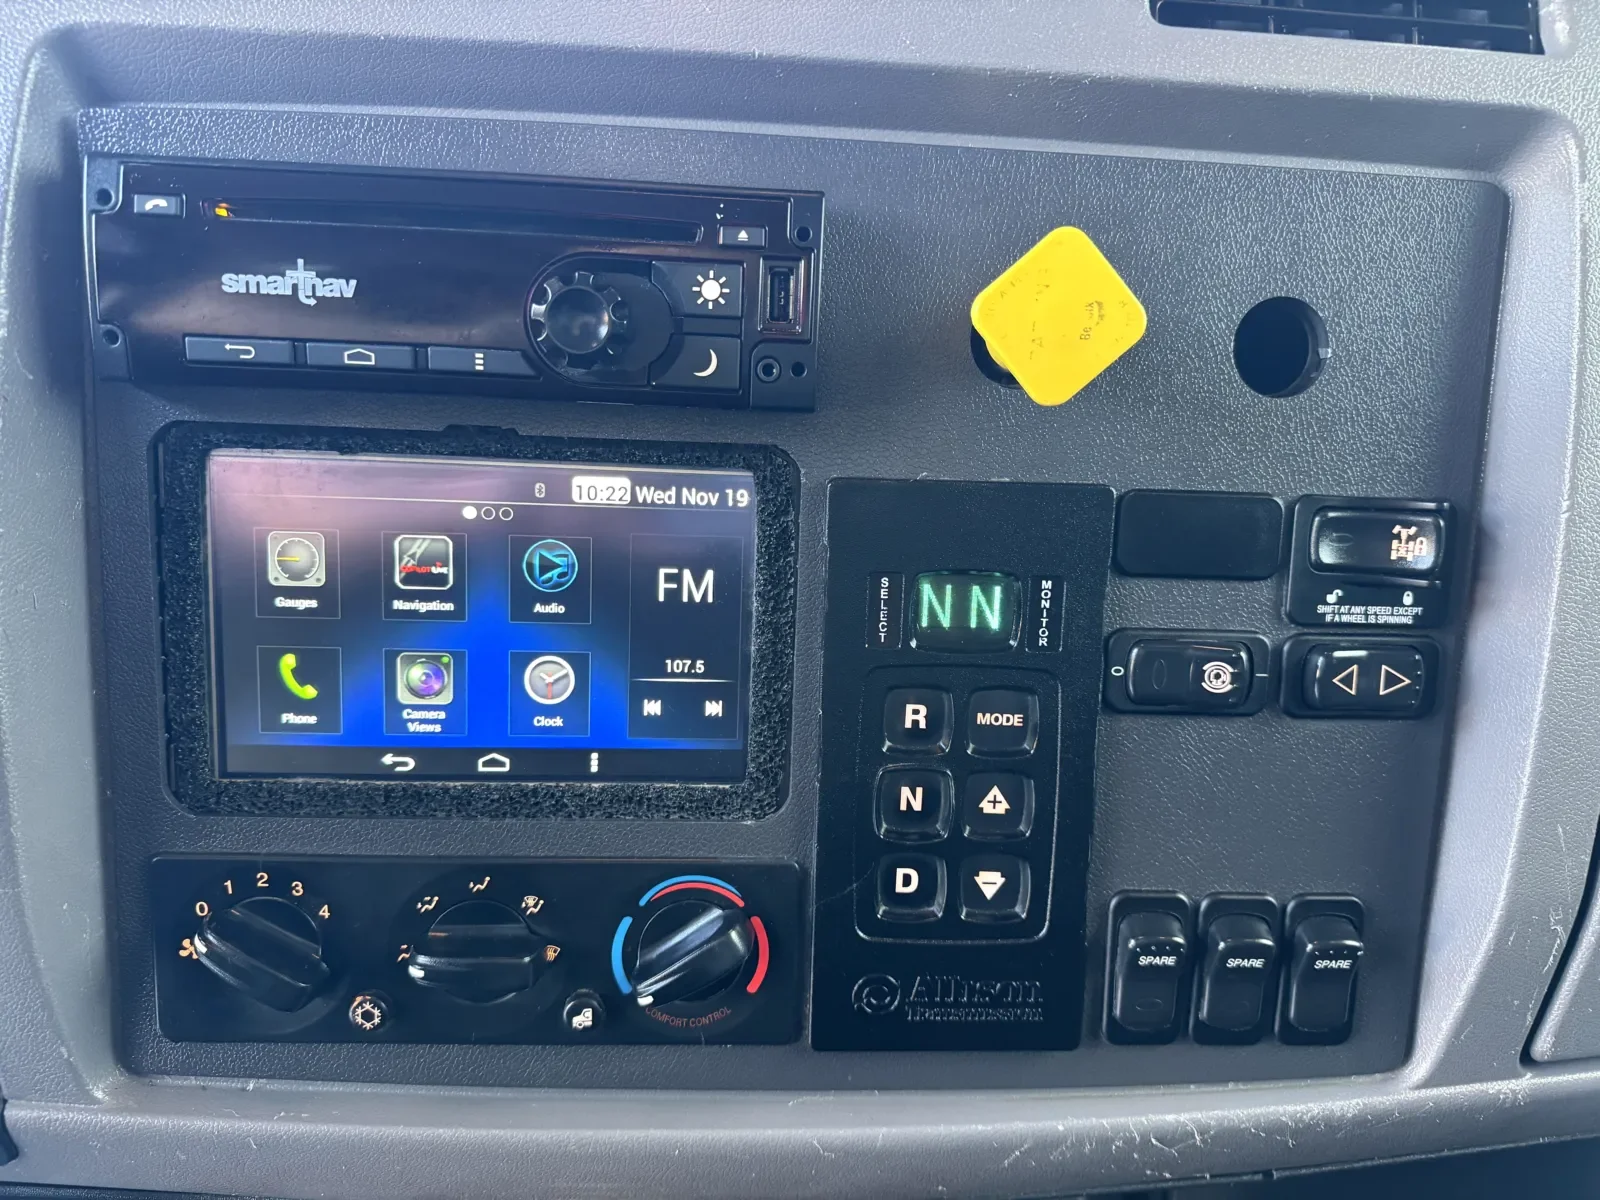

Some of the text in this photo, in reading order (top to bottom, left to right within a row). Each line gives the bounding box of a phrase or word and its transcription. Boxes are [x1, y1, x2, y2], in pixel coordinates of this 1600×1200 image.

[221, 258, 357, 306] smartnav
[575, 484, 629, 502] 10:22
[635, 485, 749, 508] Wed Nov 19
[658, 567, 714, 604] FM
[274, 596, 318, 611] Gauges
[392, 600, 455, 613] Navigation
[533, 602, 566, 615] Audio
[878, 577, 889, 644] SELECT
[920, 583, 953, 630] N
[968, 585, 1002, 632] N
[1316, 604, 1424, 616] SHIFT AT ANY SPEED EXCEPT
[1038, 579, 1052, 648] MONITOR
[1325, 614, 1413, 625] IF A WHEEL IS SPINNING
[664, 659, 706, 674] 107.5
[281, 712, 318, 725] Phone
[402, 708, 446, 721] Camera
[533, 715, 564, 728] Clock
[903, 703, 928, 730] R
[976, 712, 1024, 727] MODE
[407, 721, 442, 734] Views
[899, 786, 923, 812] N
[223, 879, 234, 895] 1
[256, 872, 269, 888] 2
[894, 867, 919, 894] D
[291, 880, 304, 897] 3
[195, 901, 209, 917] 0
[318, 904, 331, 919] 4
[1138, 955, 1177, 967] SPARE
[1226, 958, 1265, 969] SPARE
[1314, 959, 1353, 970] SPARE
[645, 1005, 732, 1028] COMFORT CONTROL
